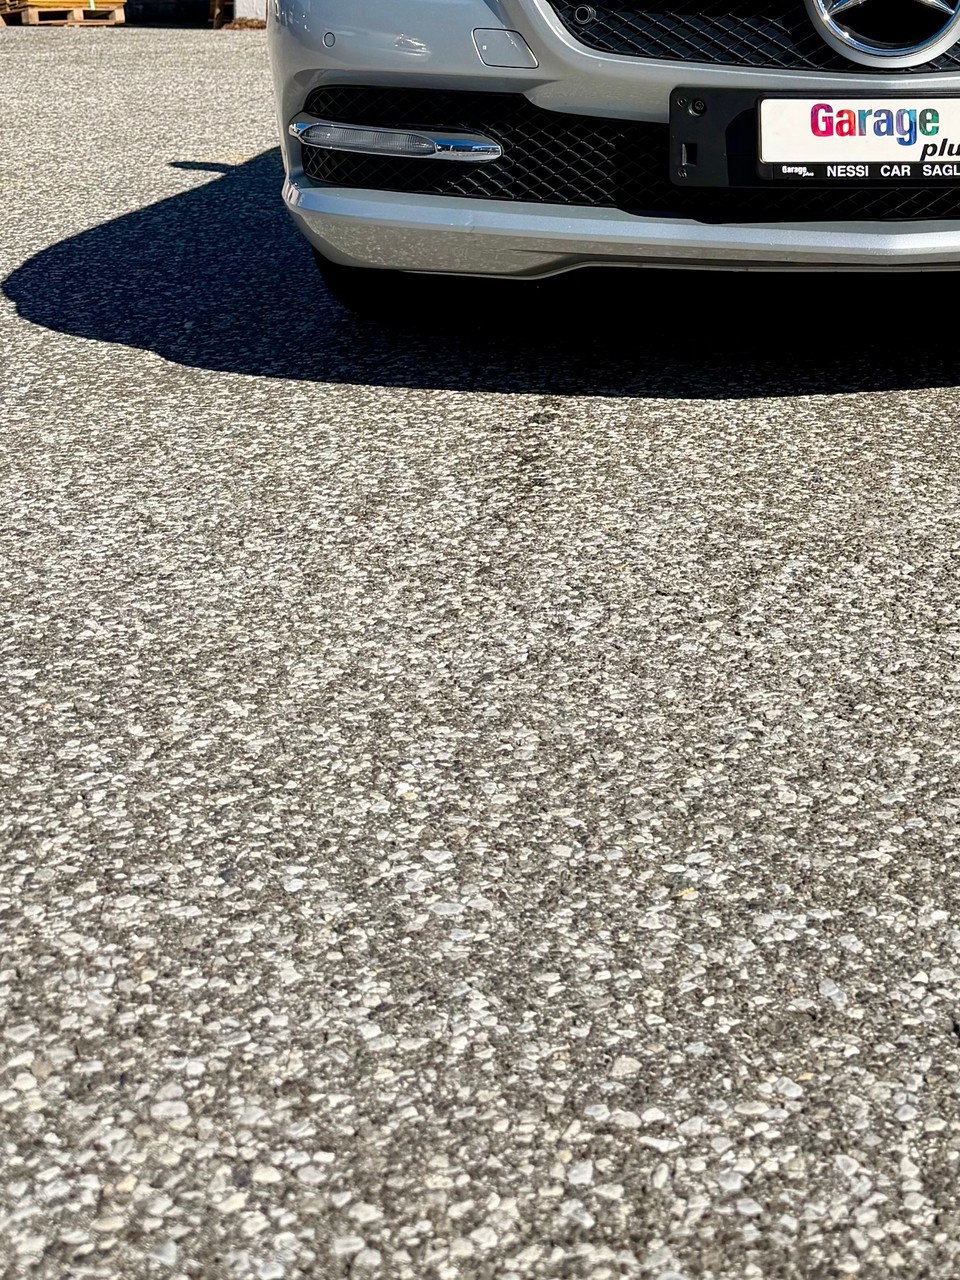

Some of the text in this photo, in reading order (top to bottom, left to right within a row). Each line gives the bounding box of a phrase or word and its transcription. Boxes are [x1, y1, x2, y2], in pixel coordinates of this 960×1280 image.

[810, 103, 940, 146] Garage
[826, 166, 869, 177] NESSI
[880, 166, 911, 177] CAR
